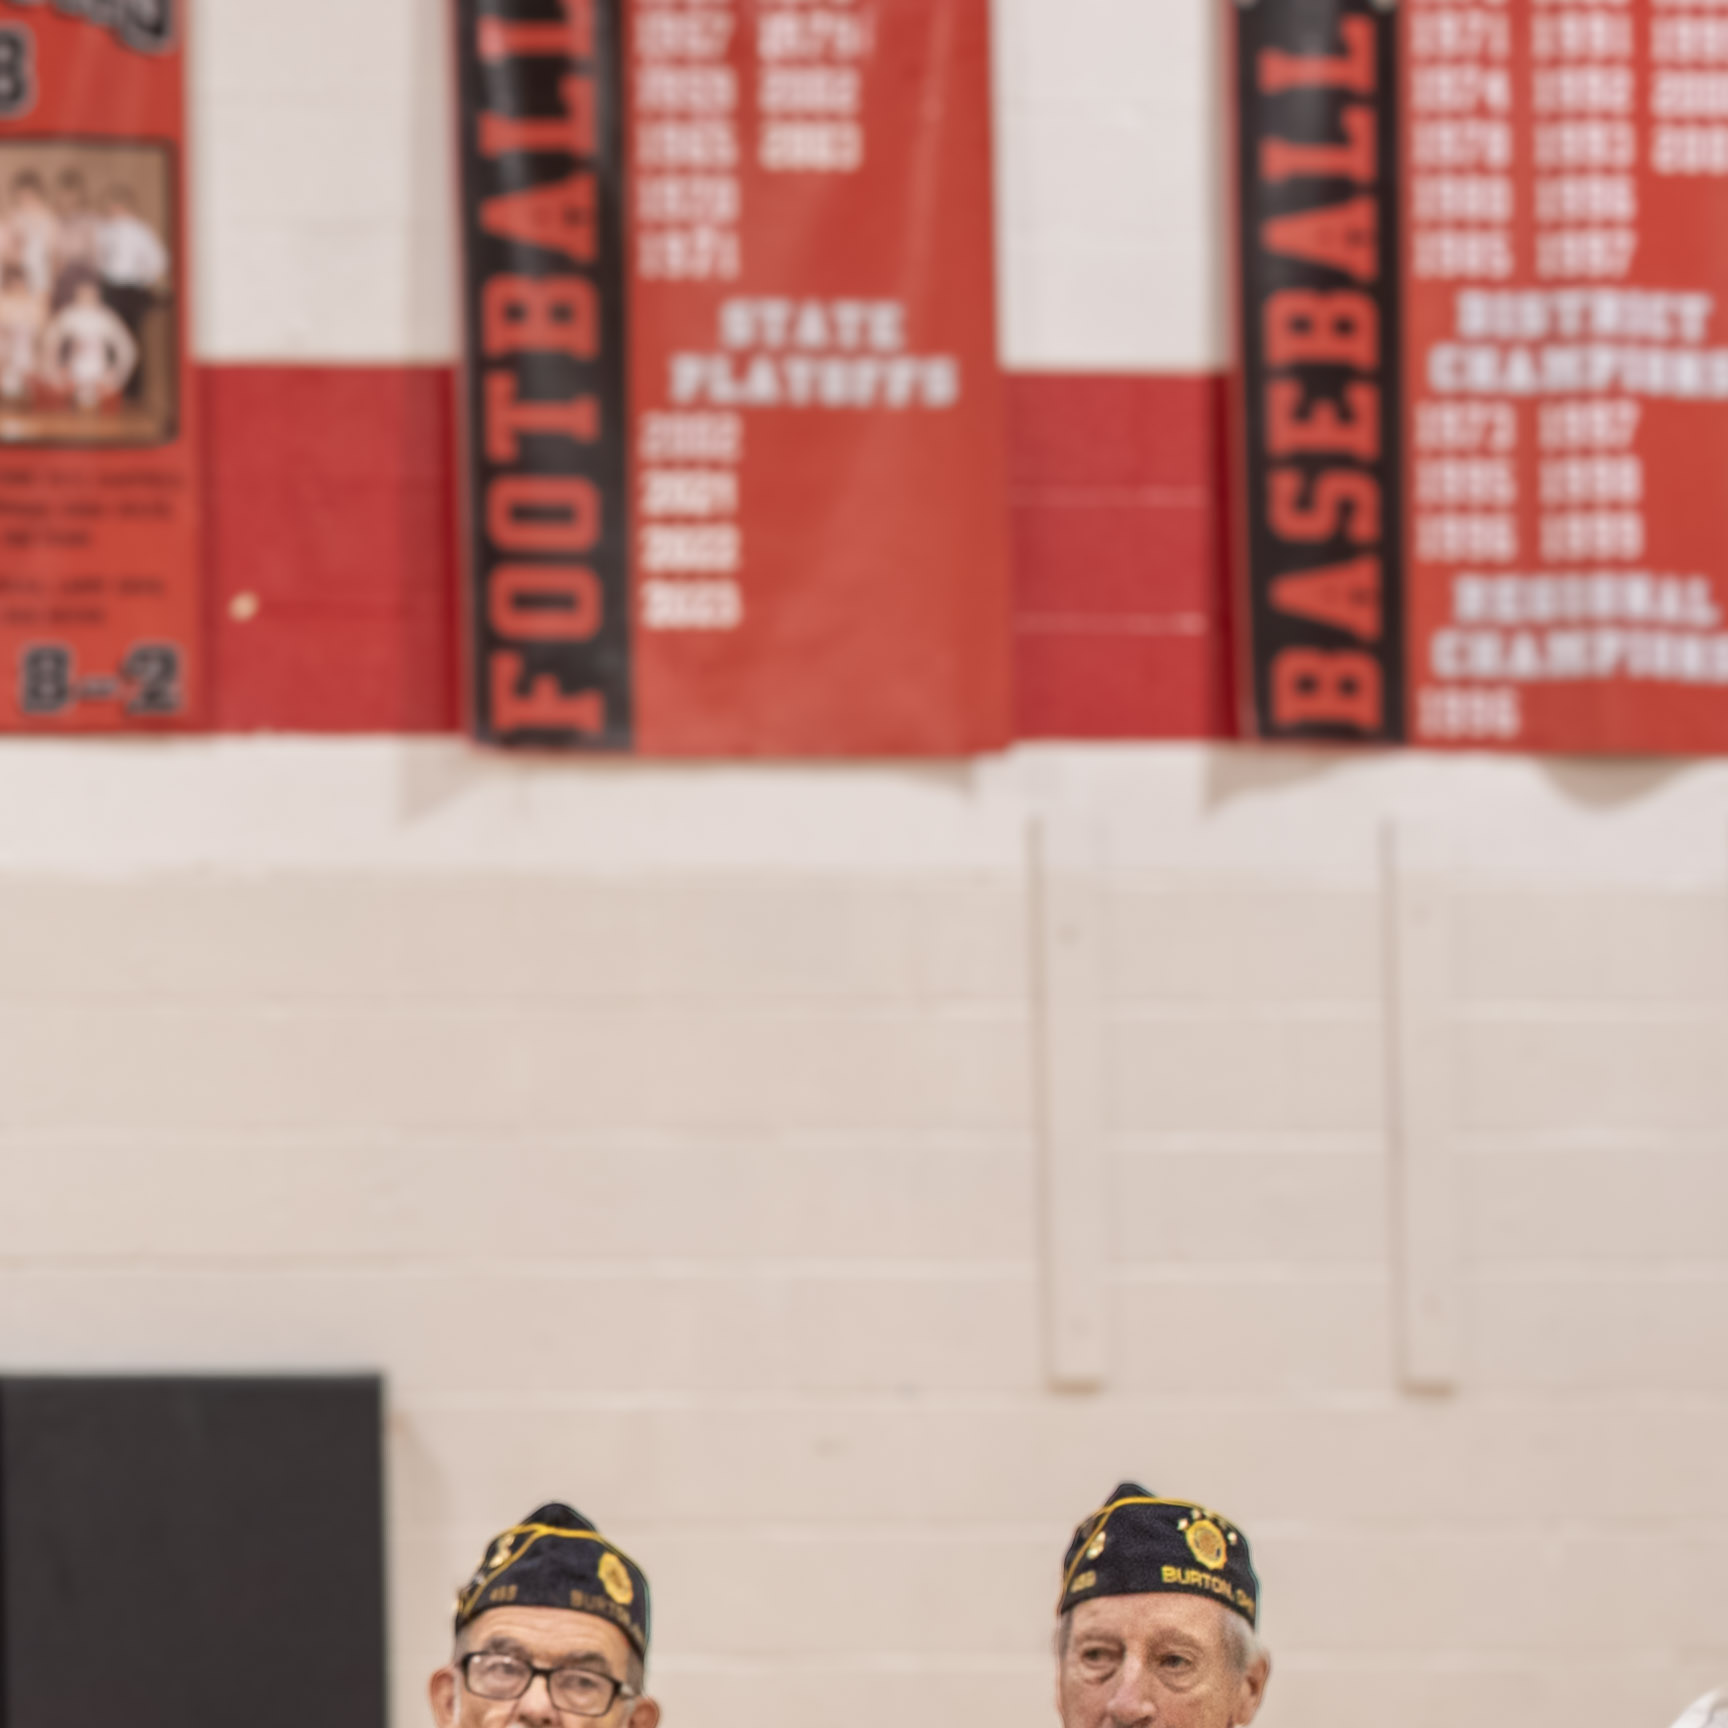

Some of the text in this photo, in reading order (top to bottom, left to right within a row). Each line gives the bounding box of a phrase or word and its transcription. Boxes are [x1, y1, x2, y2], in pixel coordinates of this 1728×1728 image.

[719, 299, 903, 351] STATE
[478, 0, 603, 735] FOOTBALL
[669, 352, 958, 407] PLAYOFFS
[1258, 15, 1382, 729] BASEBALL
[18, 641, 186, 718] 8-2
